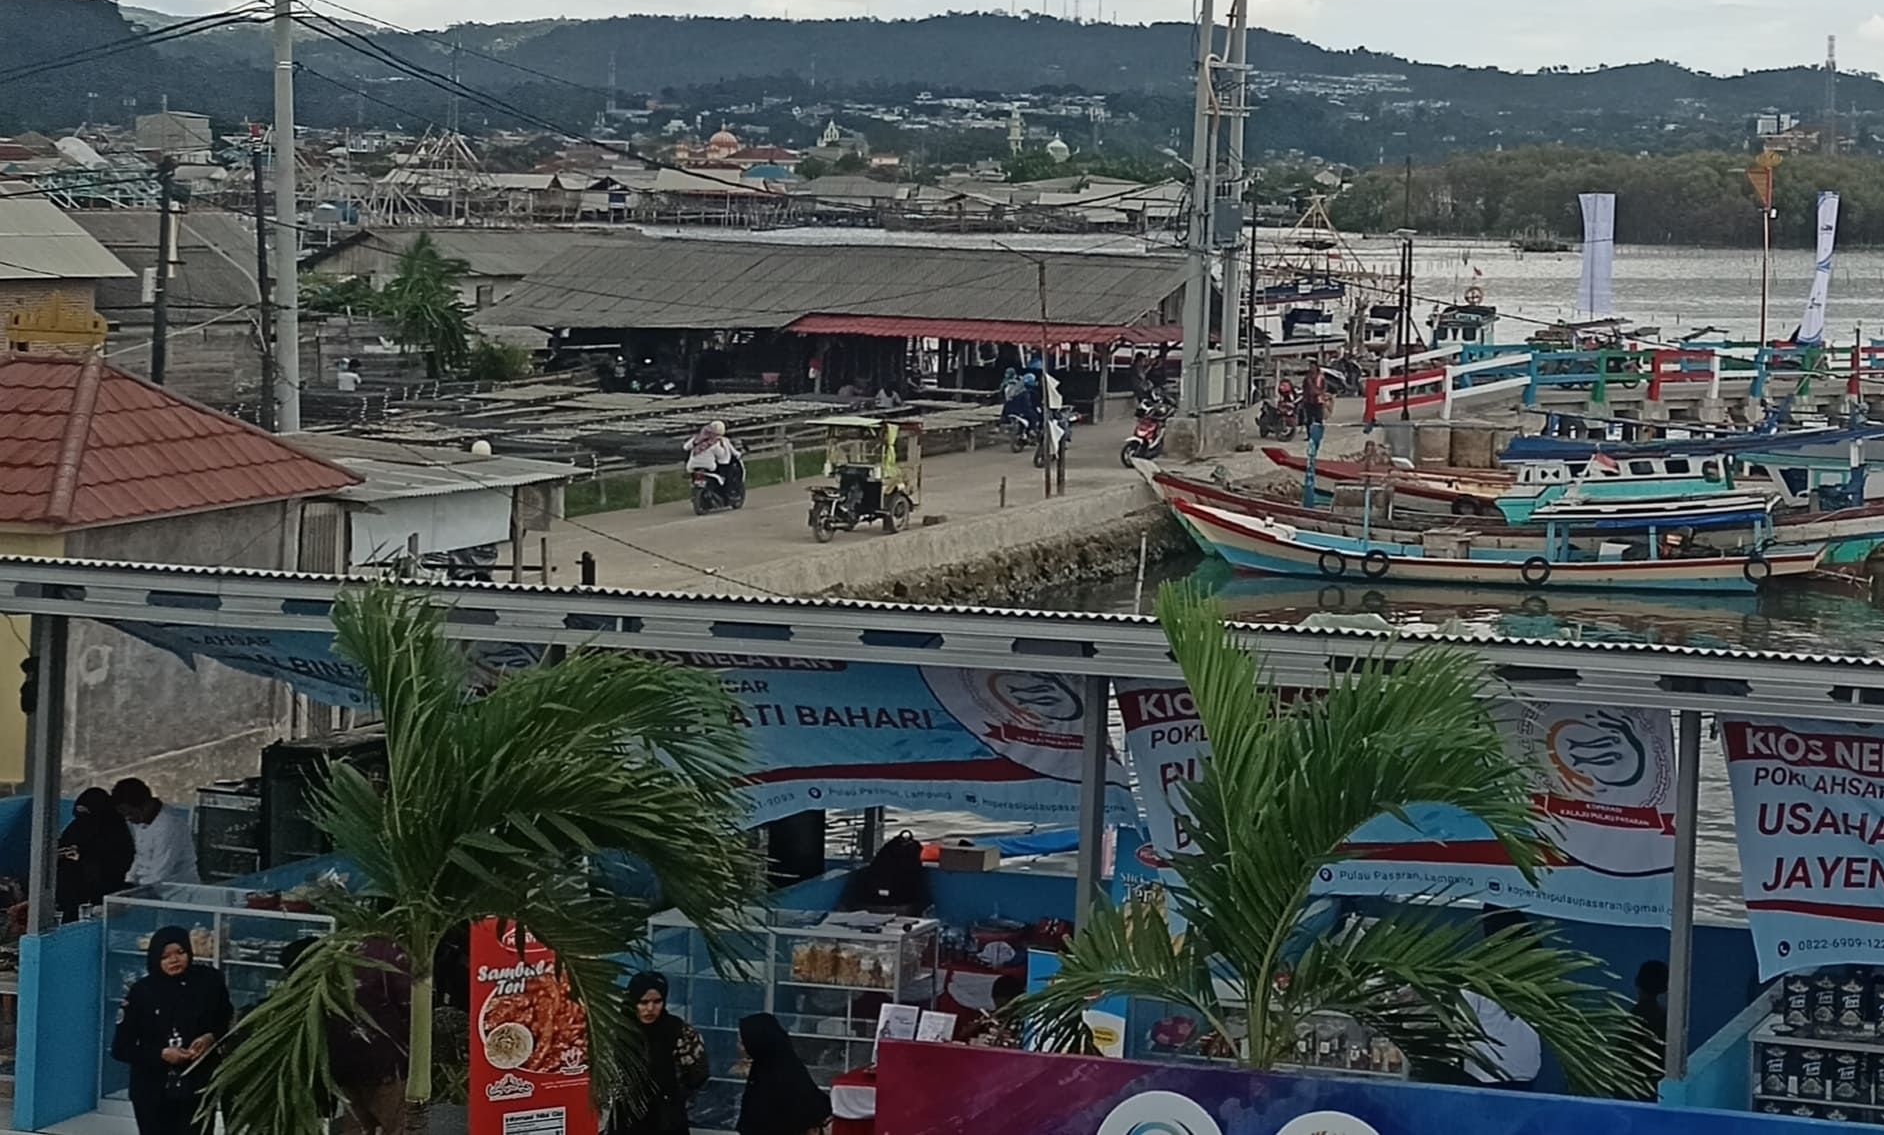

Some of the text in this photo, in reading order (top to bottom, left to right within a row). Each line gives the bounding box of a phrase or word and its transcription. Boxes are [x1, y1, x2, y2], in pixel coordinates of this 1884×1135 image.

[795, 704, 937, 731] BAHARI
[1137, 692, 1199, 722] KIO
[1745, 727, 1827, 762] KIOS
